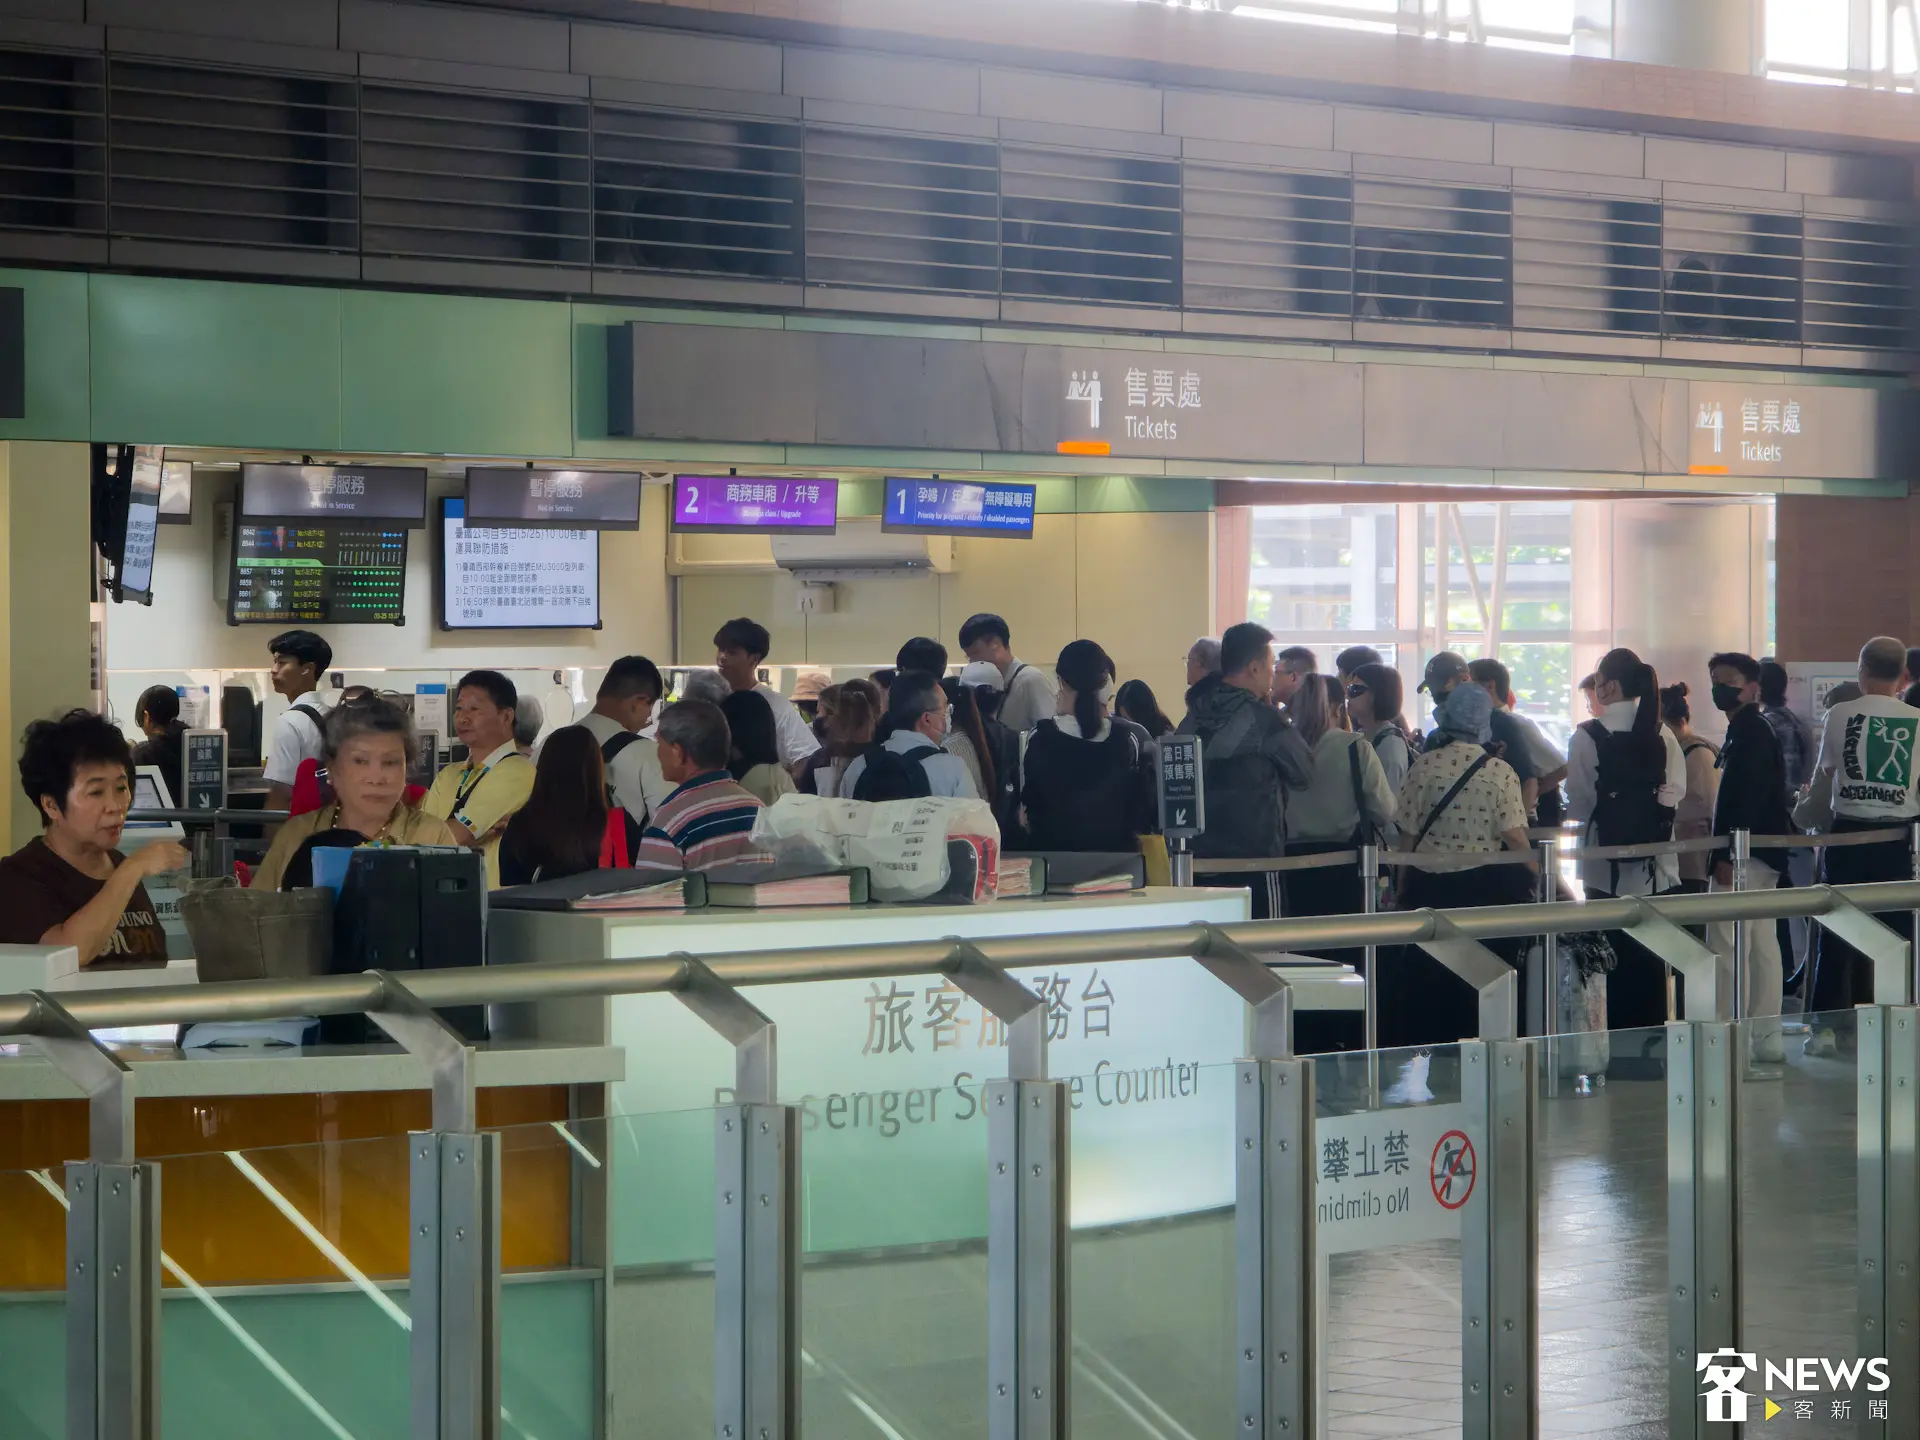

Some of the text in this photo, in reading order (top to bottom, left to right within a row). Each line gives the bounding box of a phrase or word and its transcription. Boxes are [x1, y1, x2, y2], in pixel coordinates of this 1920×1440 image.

[1124, 367, 1202, 409] 售票處
[1124, 415, 1177, 440] Tickets
[1740, 398, 1801, 435] 售票處
[1740, 440, 1782, 462] Tickets
[684, 486, 699, 514] 2
[727, 483, 777, 503] 商務車廂
[795, 485, 820, 504] 升等
[896, 488, 906, 515] 1
[917, 487, 938, 503] 孕婦
[917, 511, 935, 521] Priority
[1163, 744, 1194, 762] 當日票
[1164, 763, 1195, 780] 預售票
[1094, 1056, 1200, 1107] Counter
